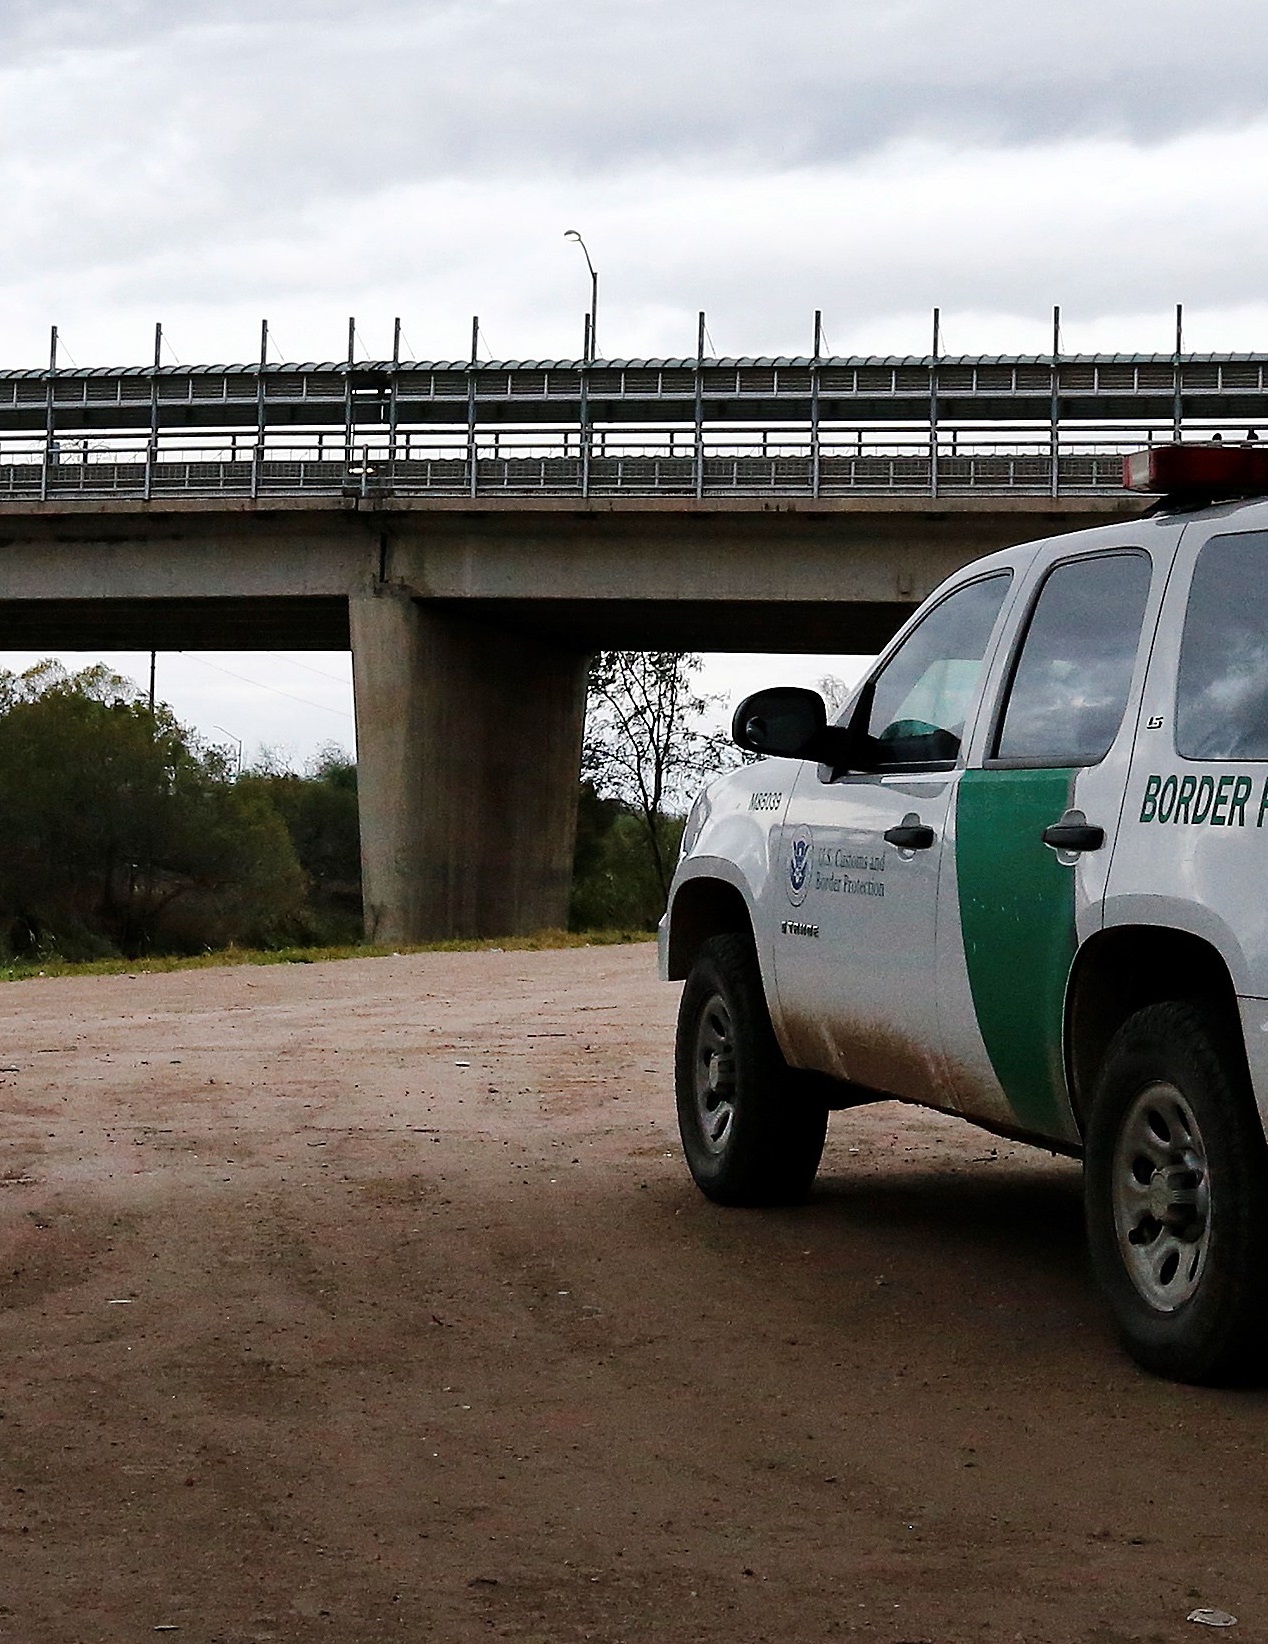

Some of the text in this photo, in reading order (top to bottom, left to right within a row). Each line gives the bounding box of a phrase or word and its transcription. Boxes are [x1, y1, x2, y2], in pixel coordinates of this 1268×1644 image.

[748, 792, 783, 811] M85039
[1139, 775, 1252, 827] BORDER
[835, 849, 869, 871] Customs
[869, 851, 886, 872] and
[815, 871, 885, 897] Border Protection
